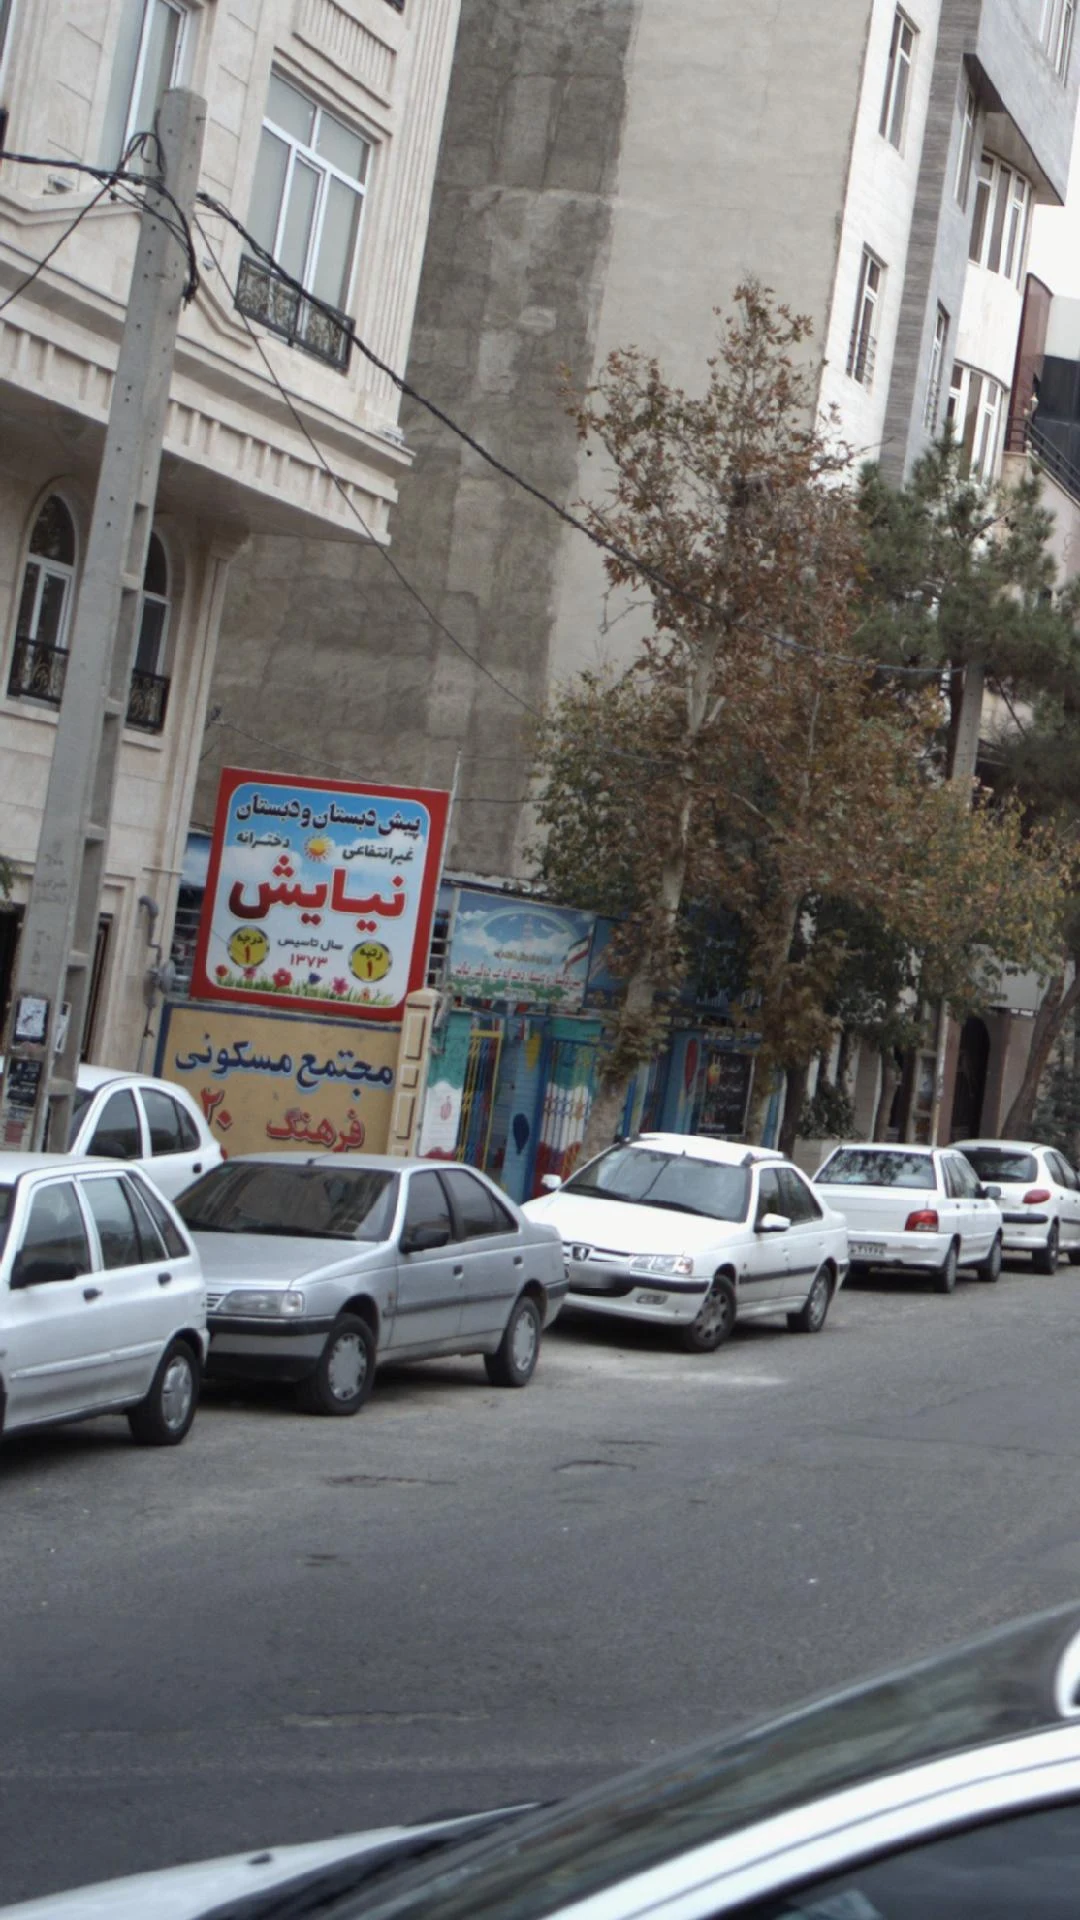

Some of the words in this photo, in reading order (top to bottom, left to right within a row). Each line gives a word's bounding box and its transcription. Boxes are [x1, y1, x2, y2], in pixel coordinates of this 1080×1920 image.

[236, 794, 300, 820] دبستان
[300, 808, 312, 827] و
[313, 803, 376, 829] دبستان
[378, 812, 421, 838] پیش
[236, 831, 290, 848] دخترانه
[342, 845, 414, 864] غیرانتفاعی
[228, 854, 406, 933] نیایش
[236, 933, 263, 945] درجه
[320, 940, 344, 951] سال
[289, 953, 328, 968] ۱۳۷۳
[359, 947, 384, 960] رتبه
[174, 1033, 292, 1075] مسکونی
[296, 1049, 395, 1097] مجتمع
[266, 1107, 366, 1153] فرهنگ
